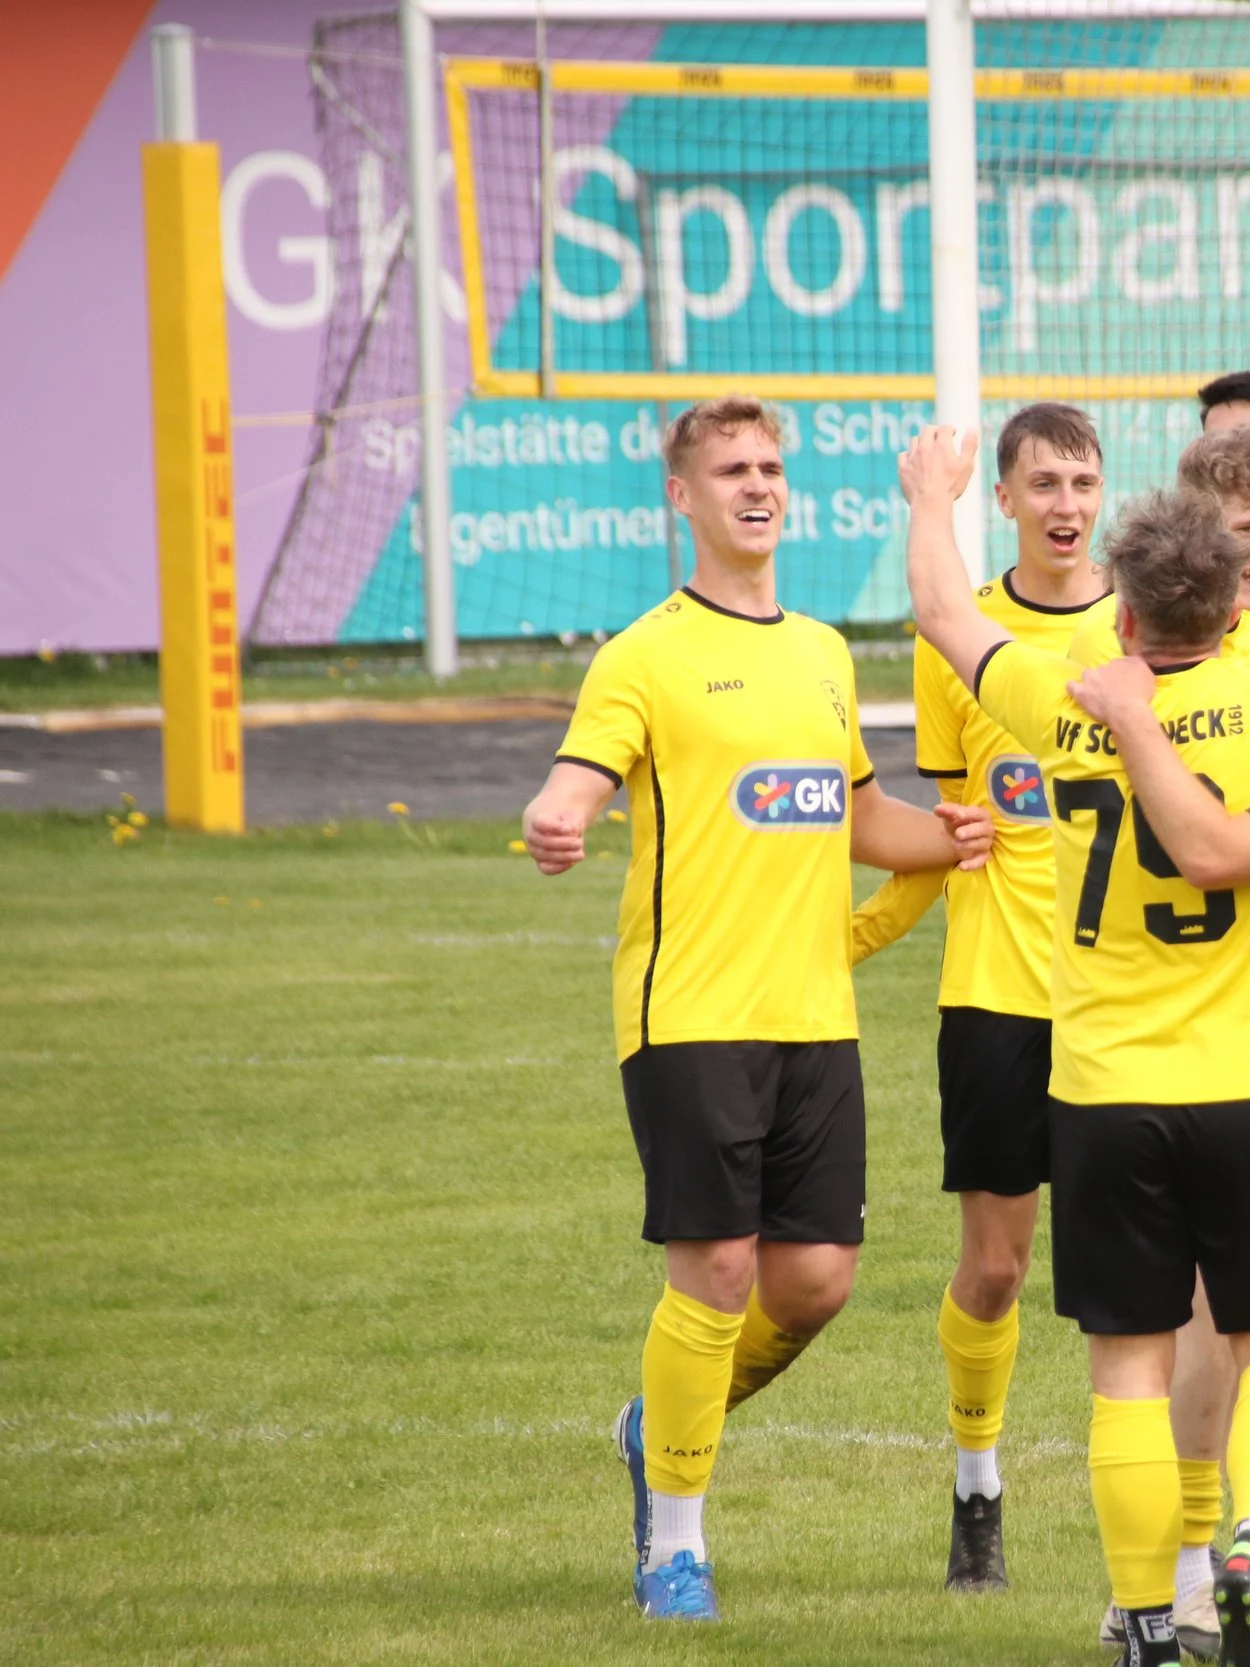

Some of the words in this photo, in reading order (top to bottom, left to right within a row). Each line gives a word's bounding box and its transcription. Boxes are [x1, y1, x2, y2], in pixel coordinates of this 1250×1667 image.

[361, 411, 611, 477] Spelstätte
[706, 679, 745, 694] JAKO
[1056, 716, 1085, 752] Vf
[1228, 703, 1244, 736] 1912
[795, 777, 842, 814] GK
[662, 1444, 713, 1458] JAKO
